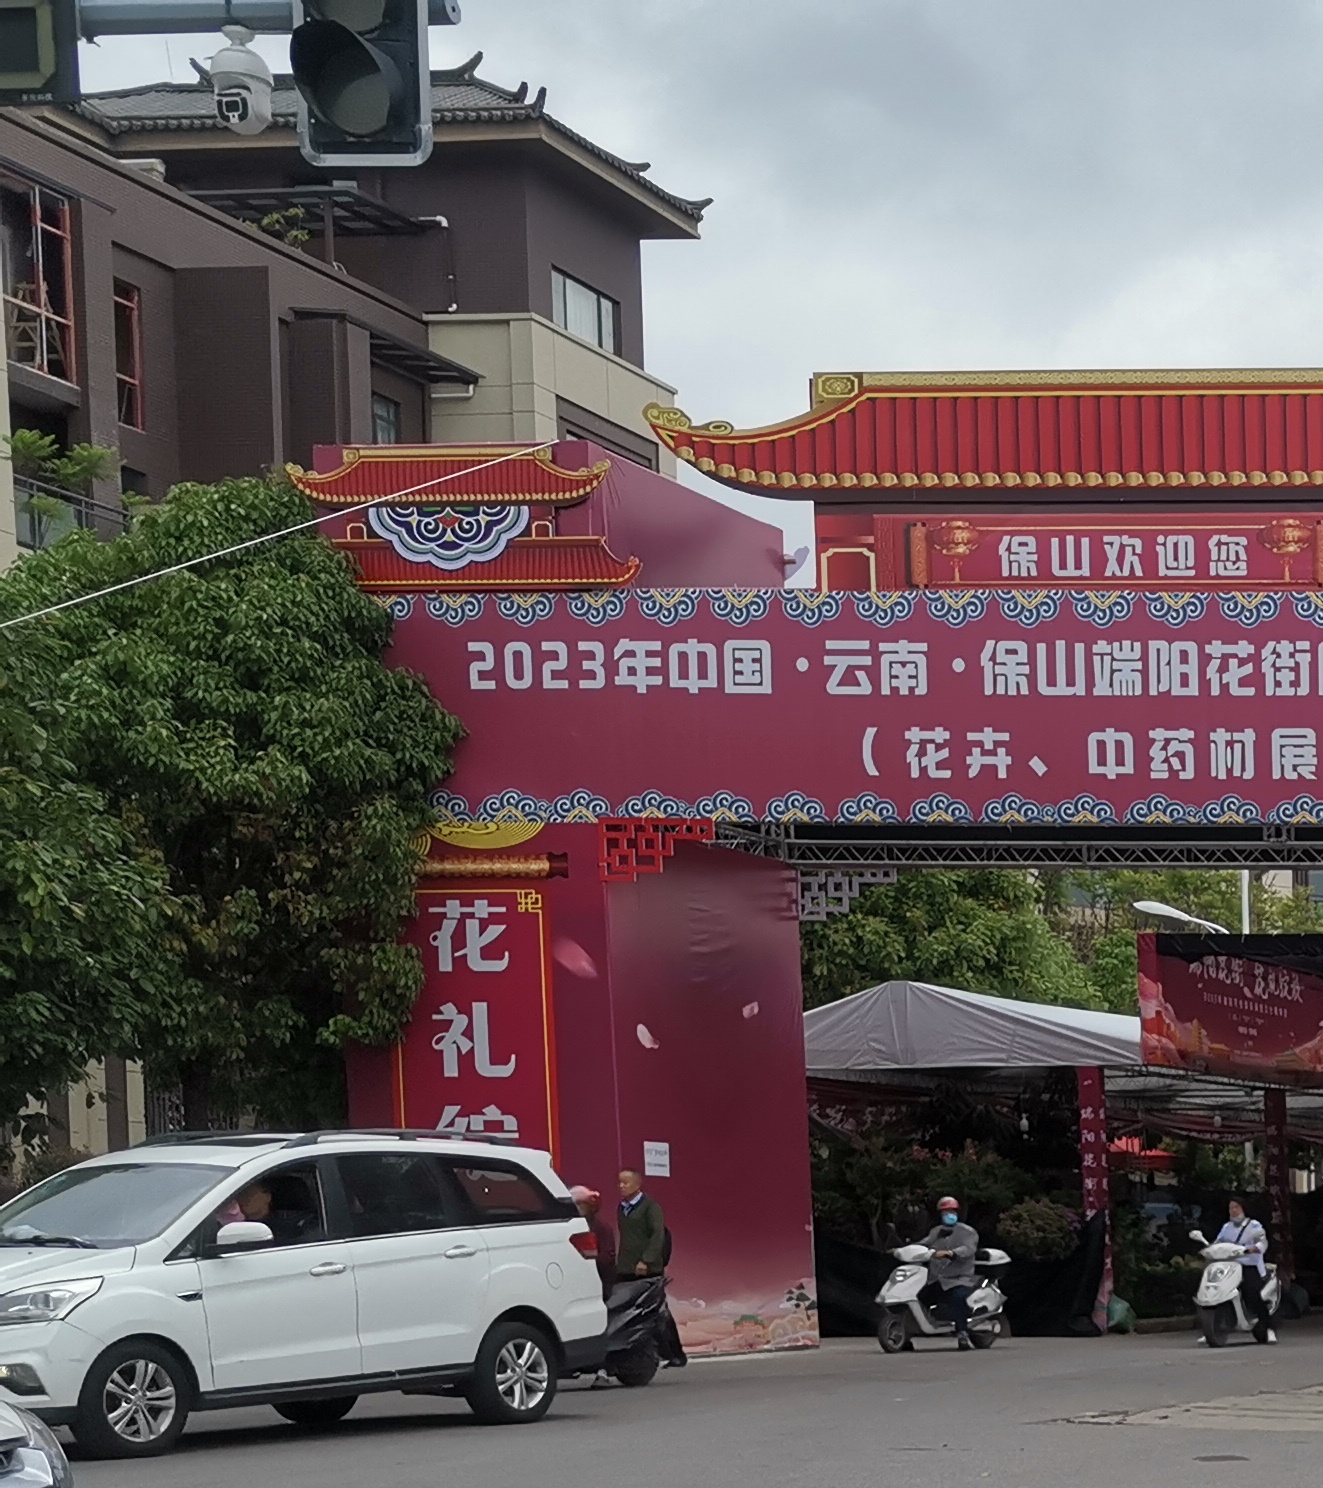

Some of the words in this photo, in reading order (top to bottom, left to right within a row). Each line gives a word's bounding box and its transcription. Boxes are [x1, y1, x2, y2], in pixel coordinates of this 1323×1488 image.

[998, 533, 1250, 579] 保山欢迎您
